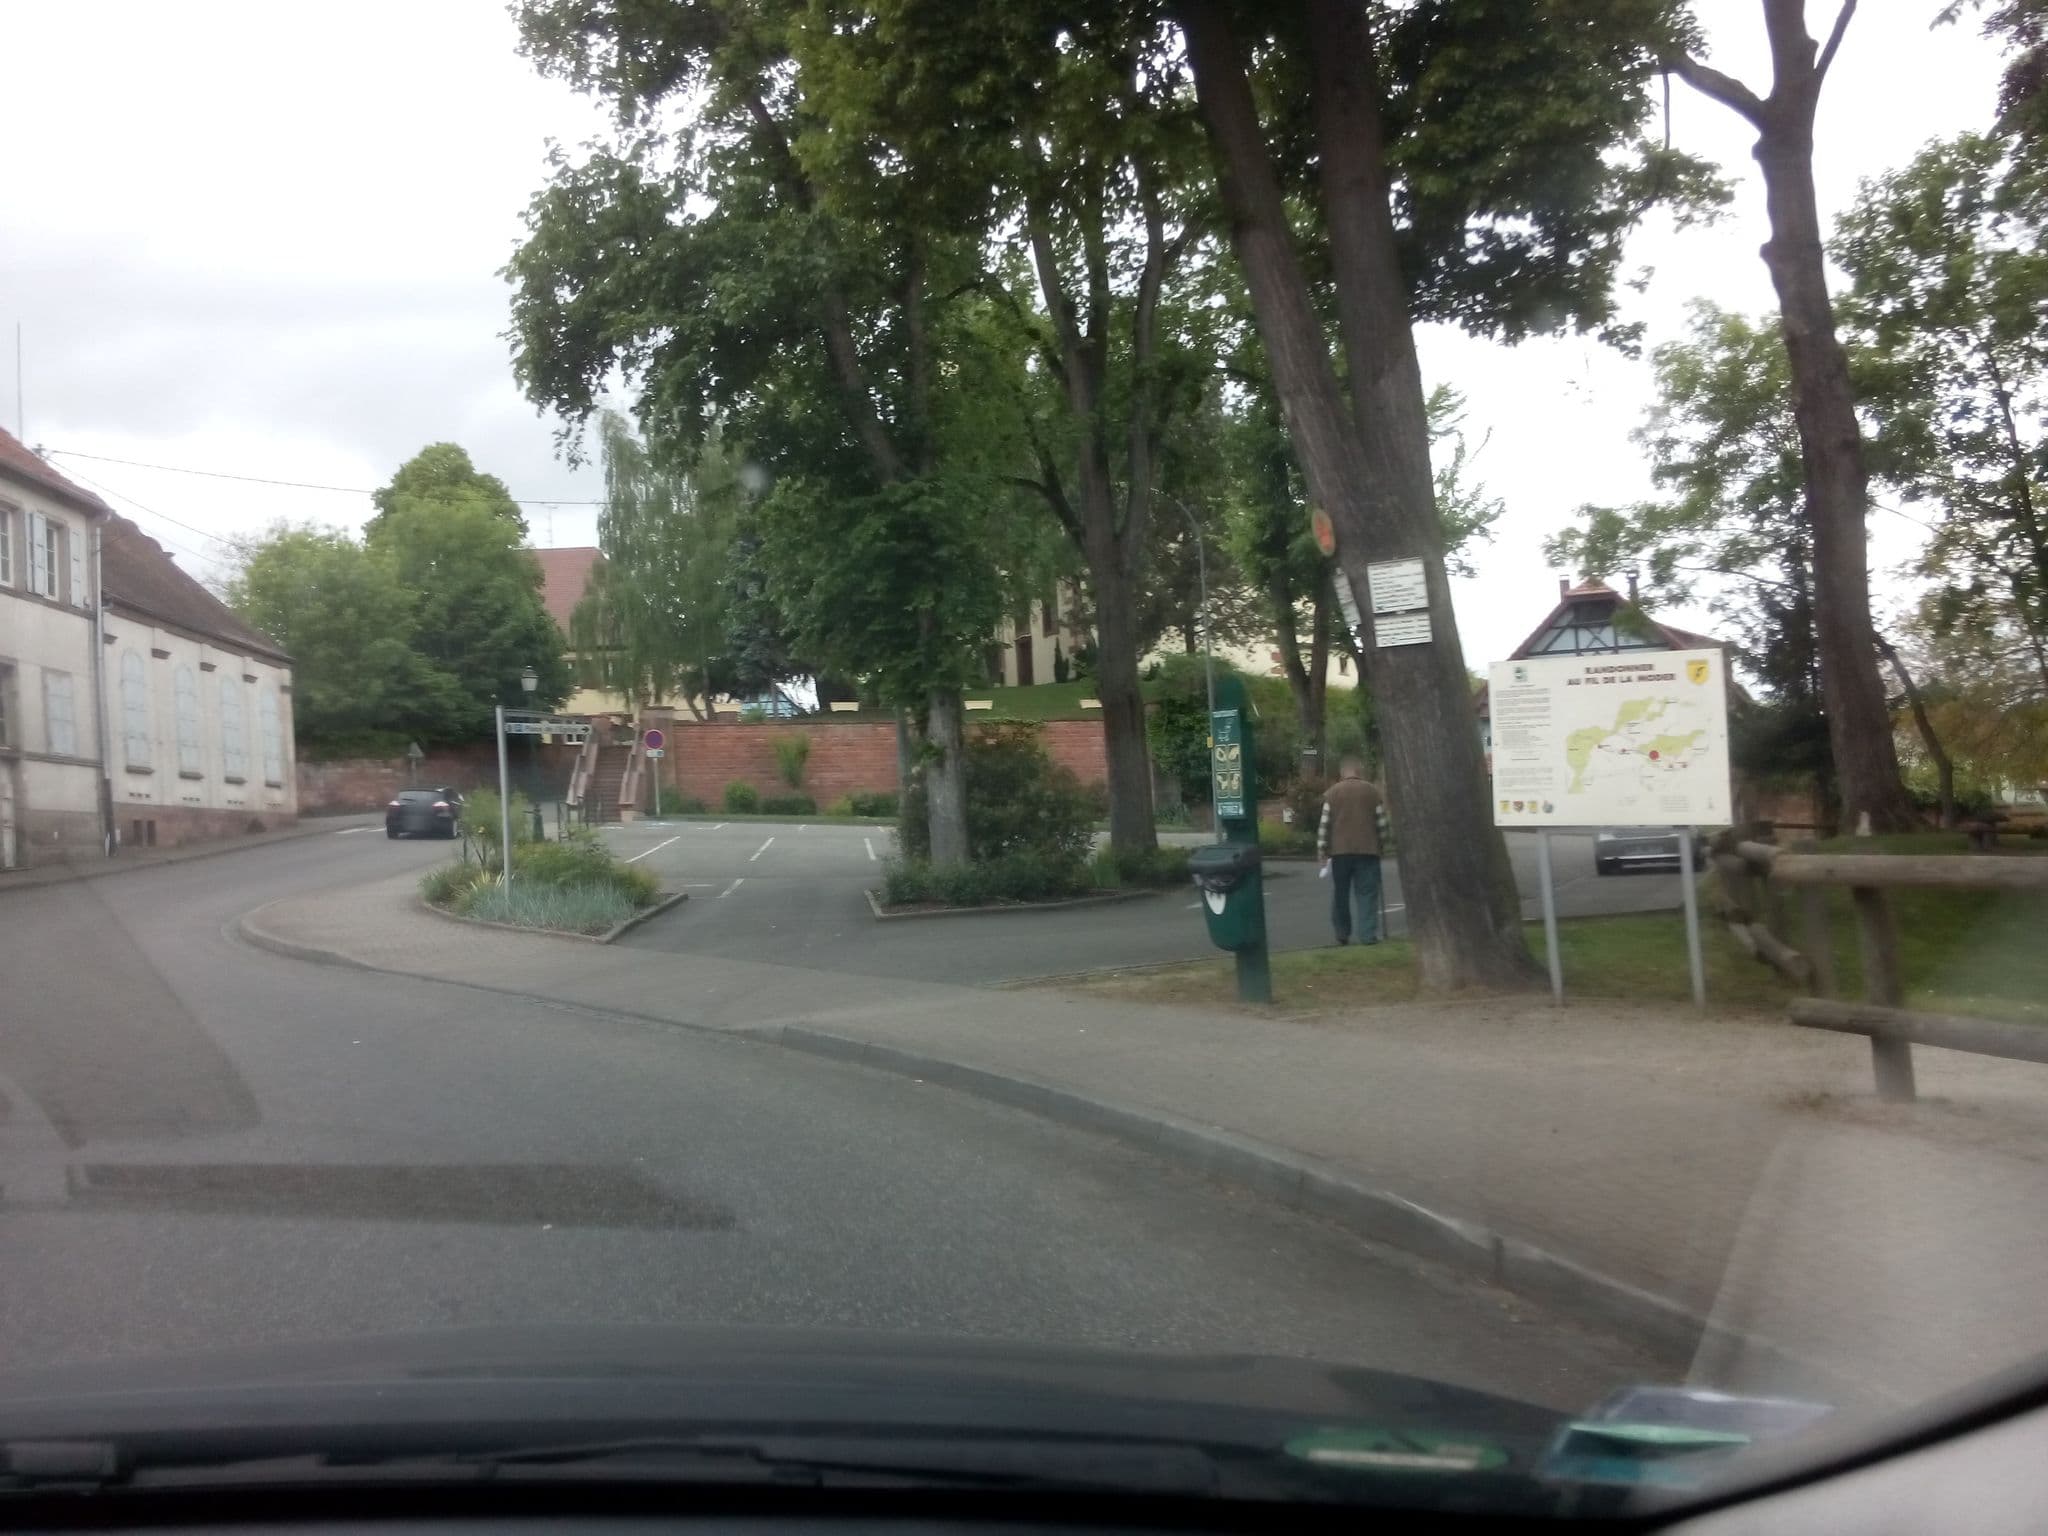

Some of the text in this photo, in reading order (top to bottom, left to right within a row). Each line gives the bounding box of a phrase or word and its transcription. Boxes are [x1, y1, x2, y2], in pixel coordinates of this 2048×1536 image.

[1568, 678, 1580, 686] AU
[1585, 677, 1600, 685] FIL
[1603, 676, 1616, 684] DE
